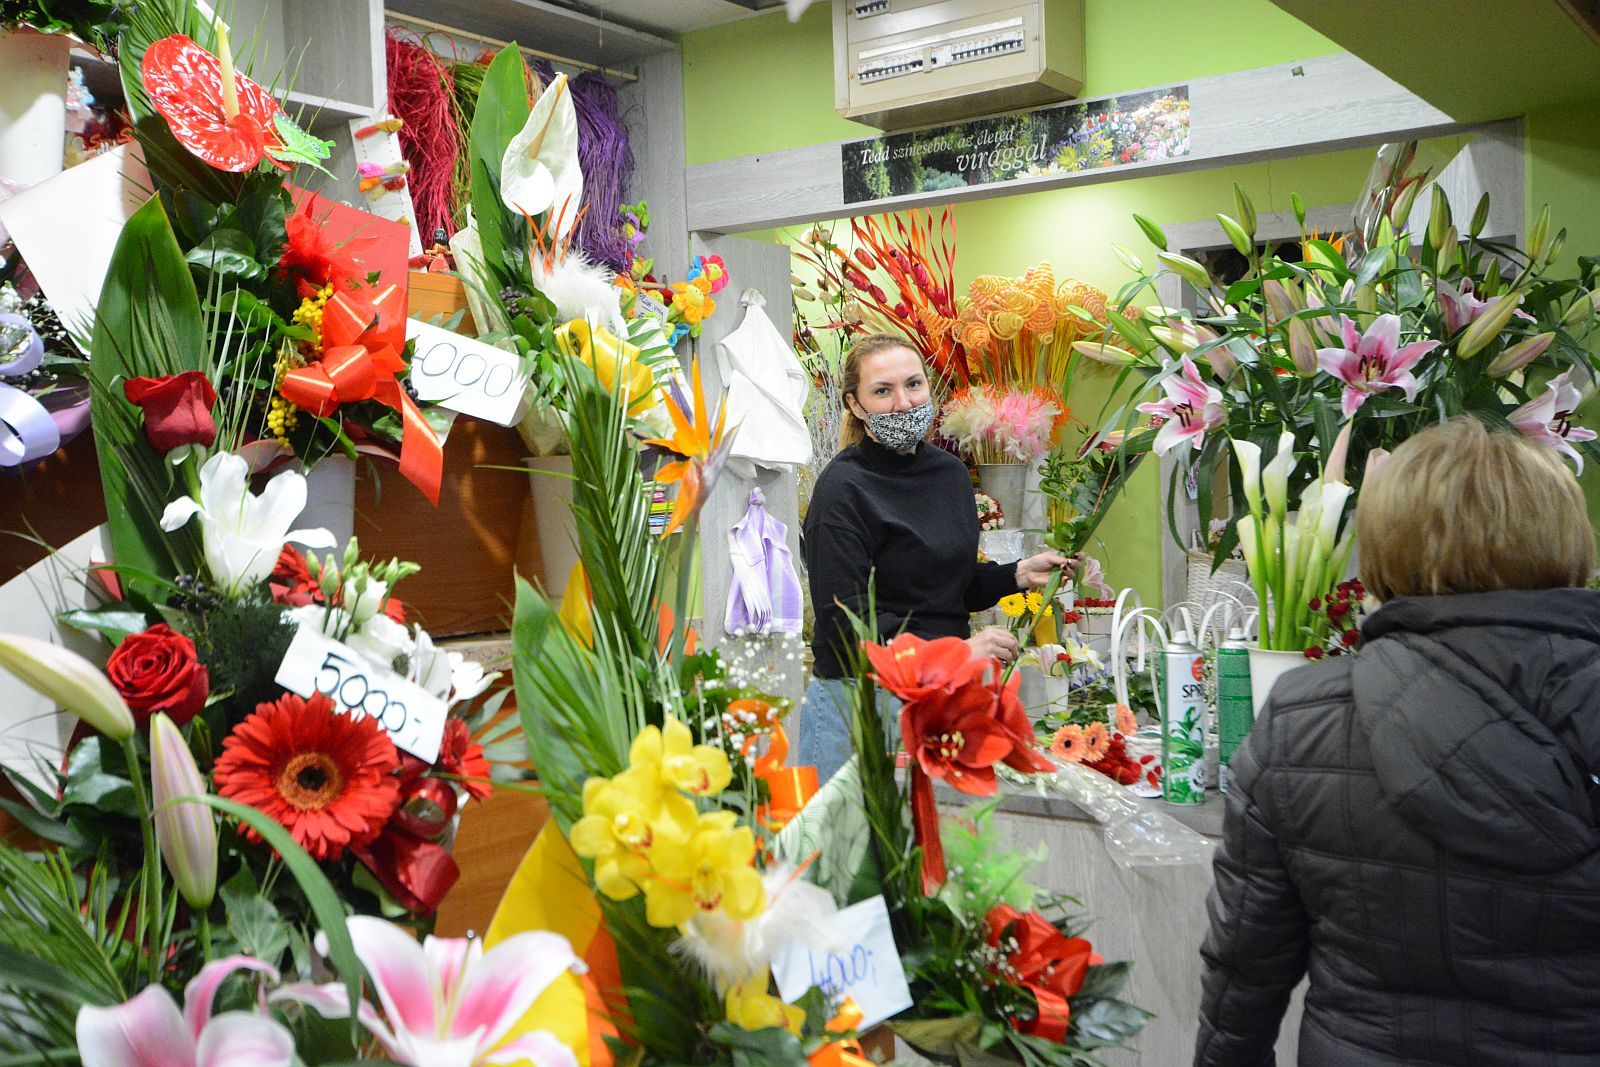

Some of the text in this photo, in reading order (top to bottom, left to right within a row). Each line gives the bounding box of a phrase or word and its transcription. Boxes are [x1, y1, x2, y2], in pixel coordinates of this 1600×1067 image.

[860, 125, 1014, 165] Tedd színesebbé az életed
[956, 134, 1047, 172] virággal
[413, 342, 514, 398] 000
